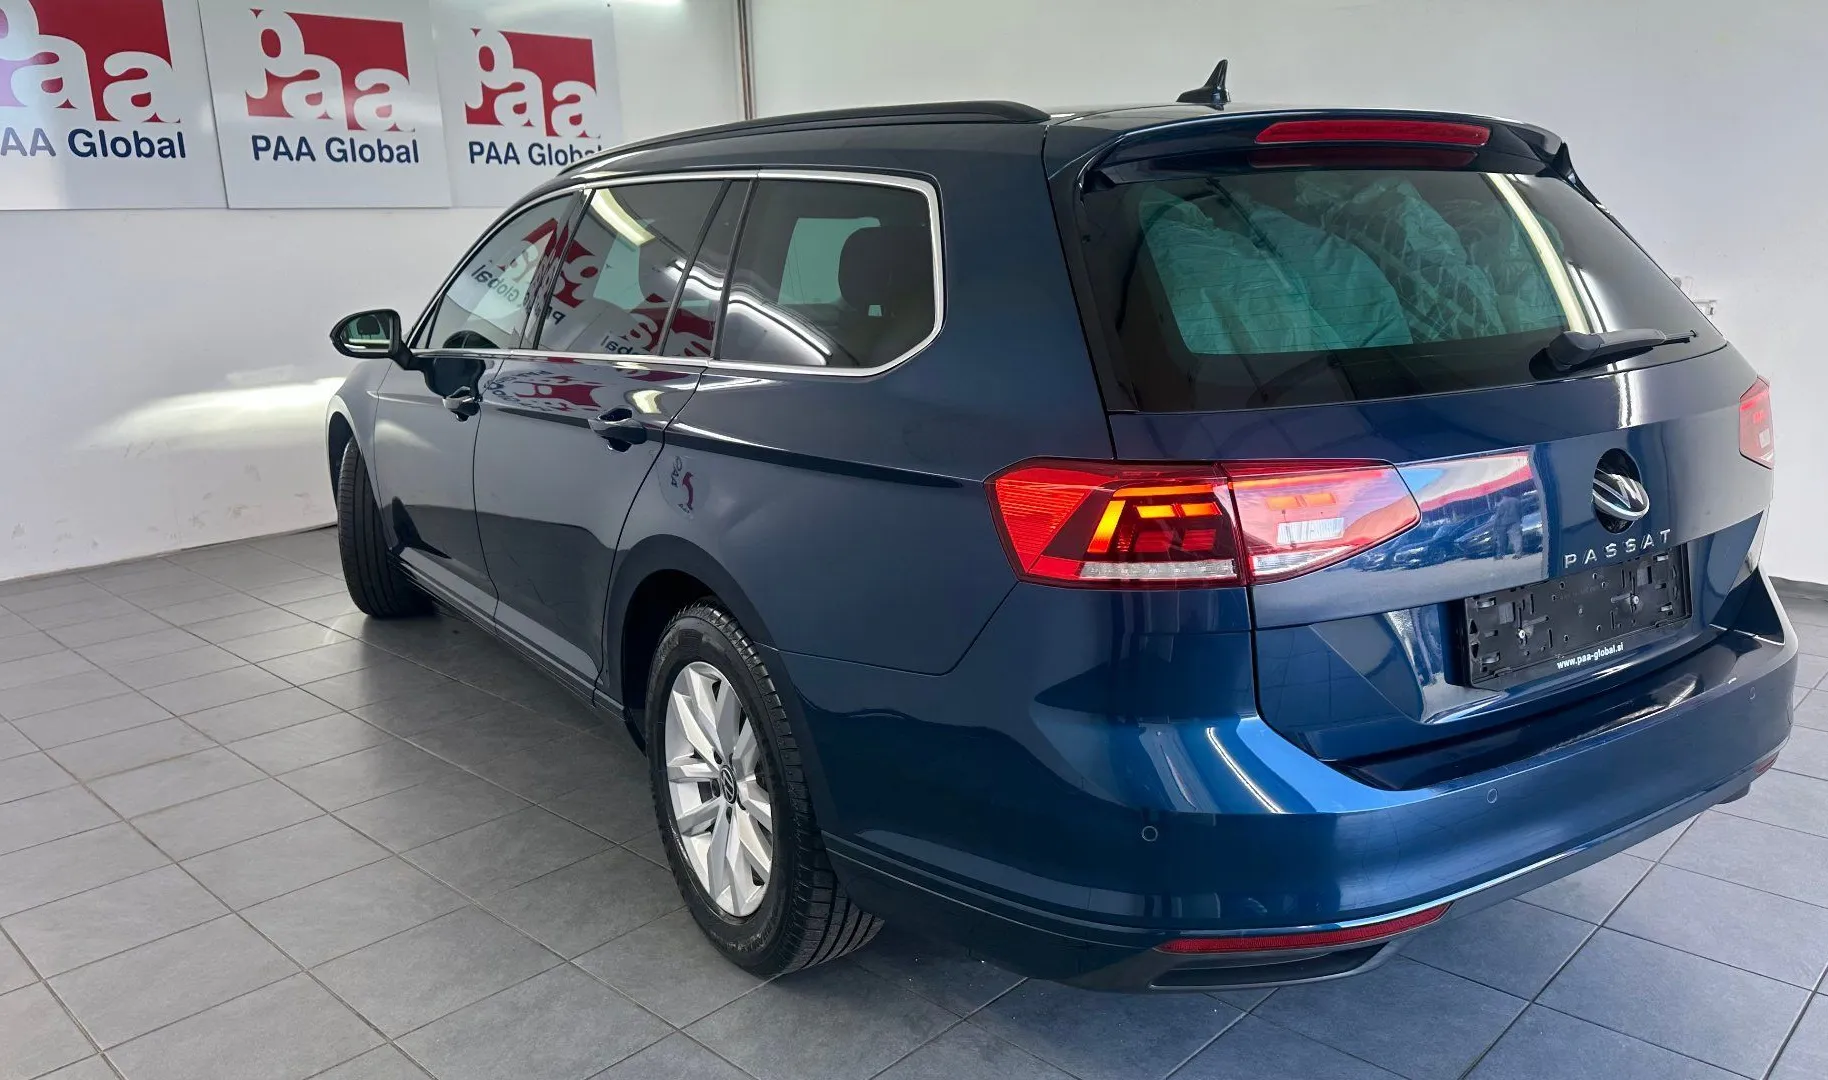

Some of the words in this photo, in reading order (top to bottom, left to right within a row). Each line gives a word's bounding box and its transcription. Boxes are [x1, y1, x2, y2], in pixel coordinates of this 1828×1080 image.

[0, 127, 56, 157] AA
[68, 128, 186, 159] Global
[252, 135, 316, 162] PAA
[325, 137, 419, 164] Global
[468, 141, 520, 165] PAA
[1563, 529, 1671, 569] PASSAT
[1557, 642, 1624, 669] www.paa-global.si
